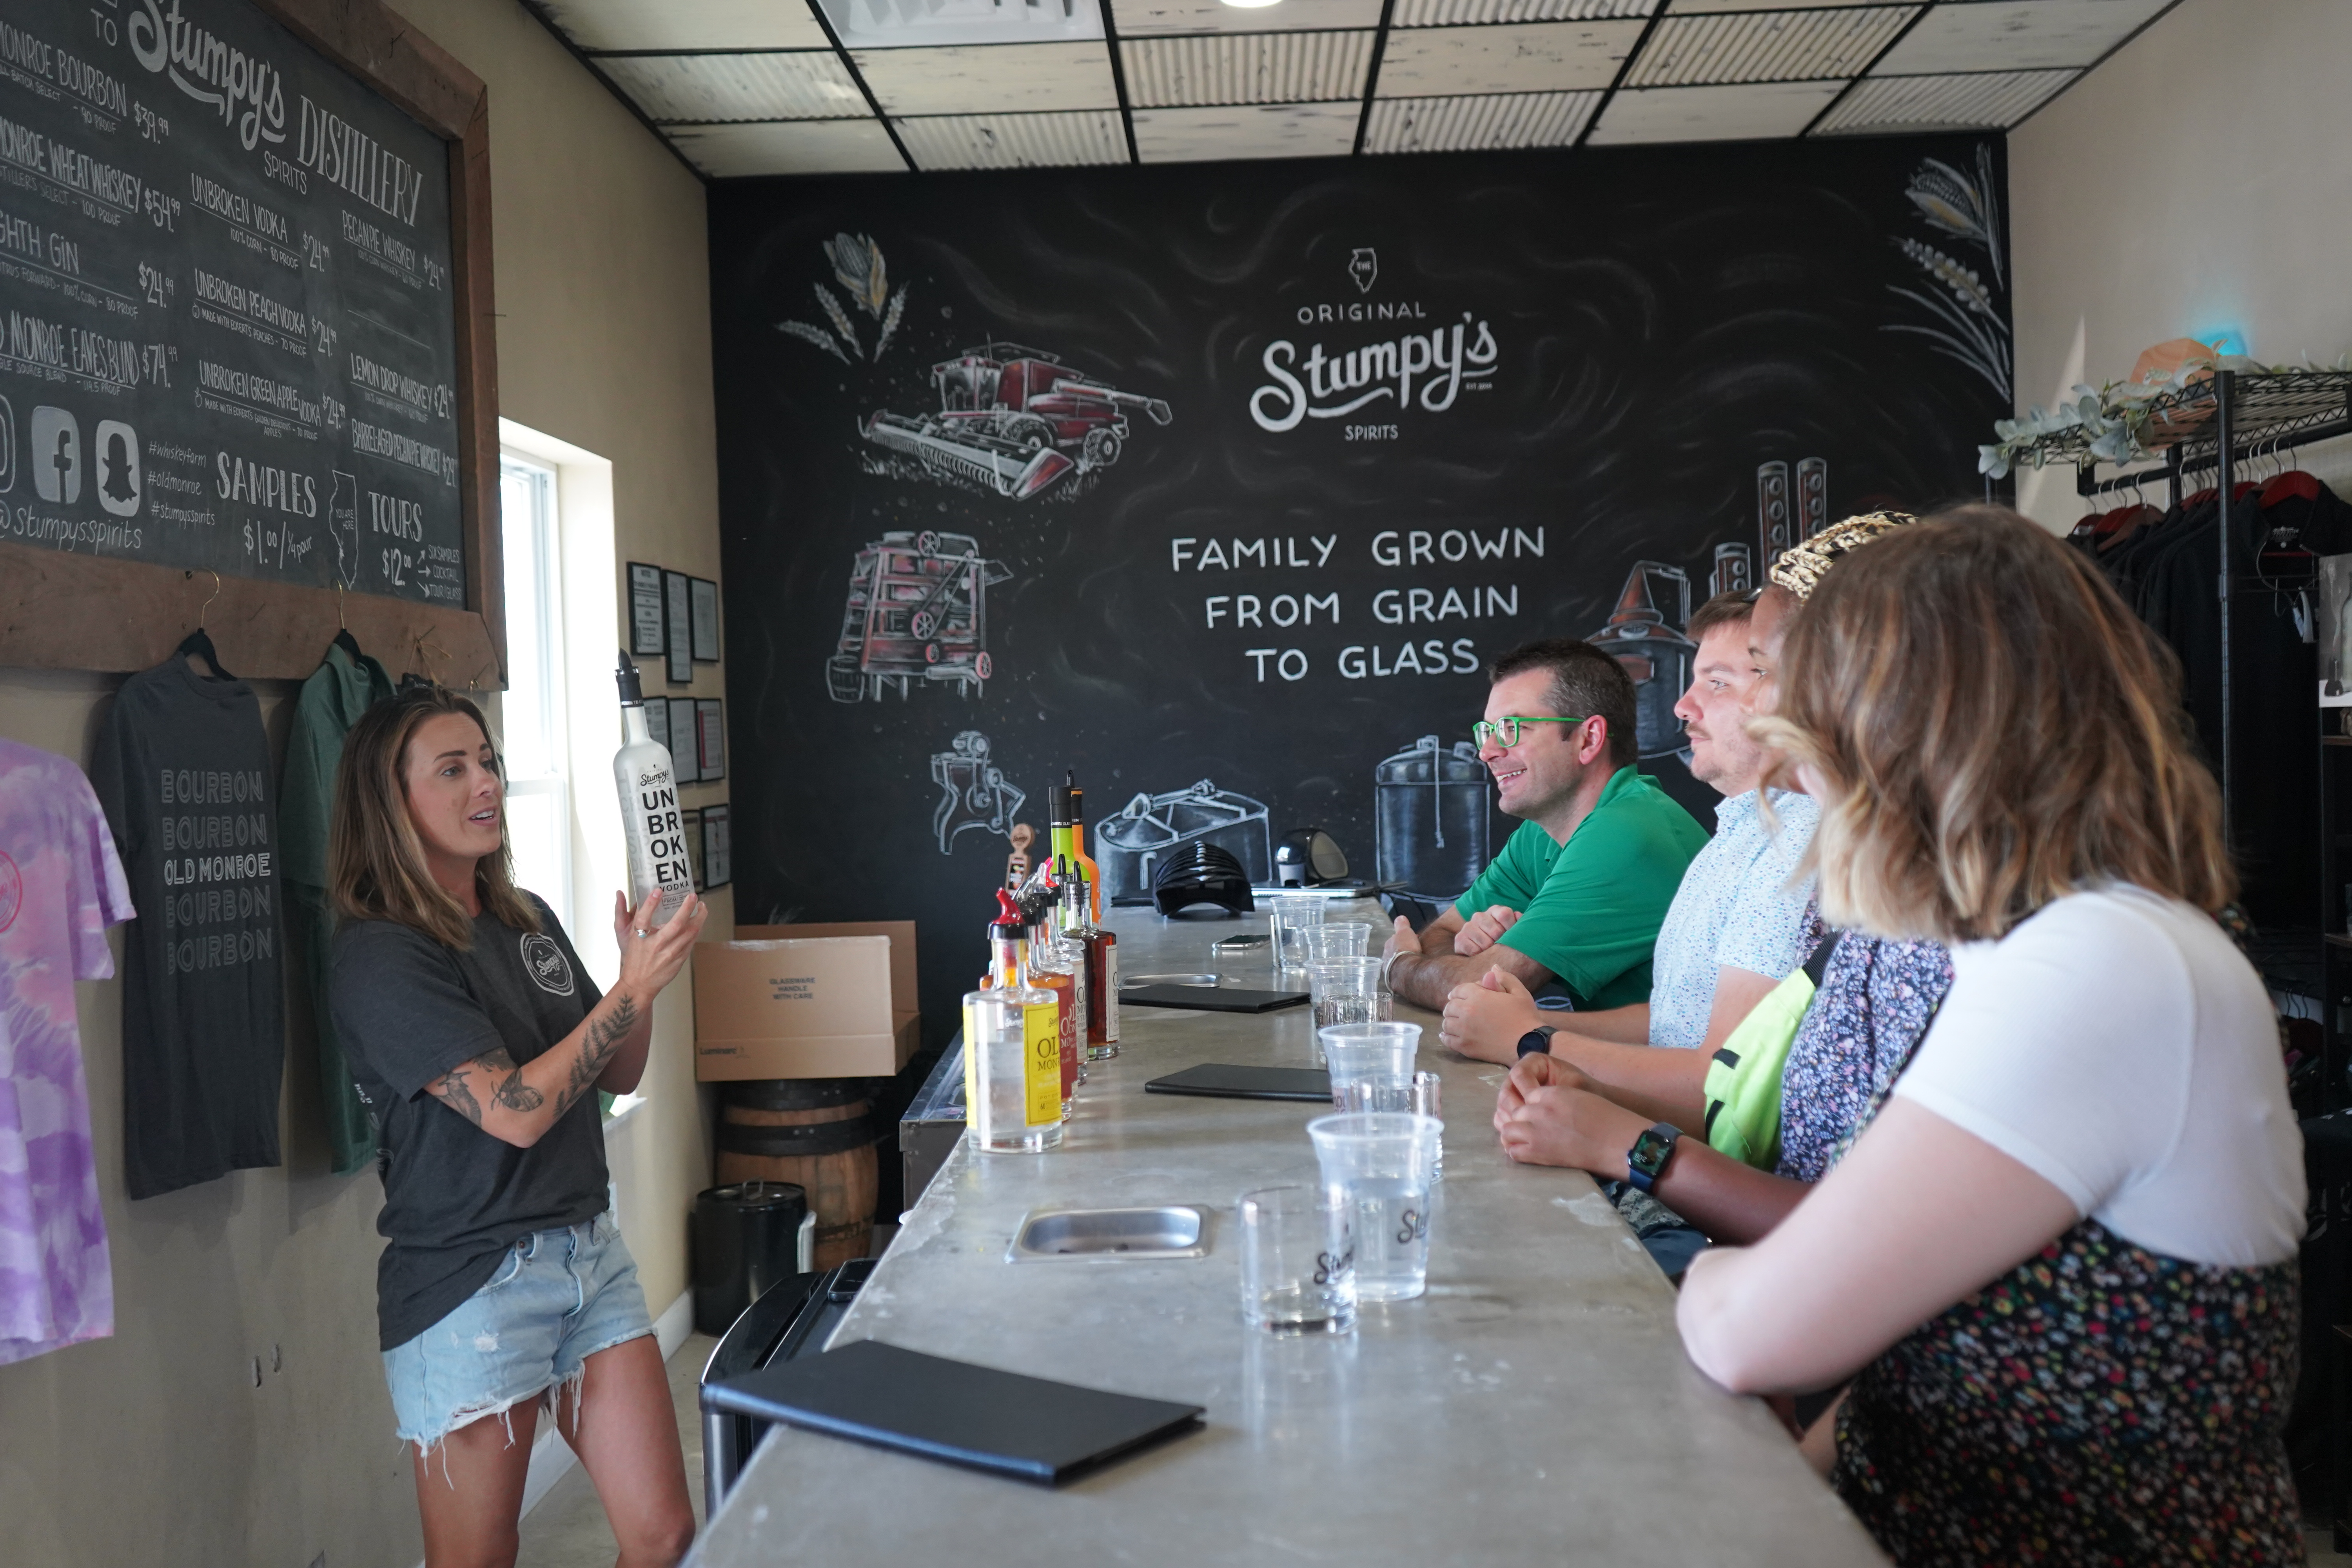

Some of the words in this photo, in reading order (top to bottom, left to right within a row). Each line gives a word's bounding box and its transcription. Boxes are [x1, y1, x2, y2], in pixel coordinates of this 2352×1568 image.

[90, 7, 118, 47] TO
[57, 49, 127, 117] BOURBON
[128, 0, 285, 151] Stumpy's
[94, 114, 116, 134] PROOF
[264, 150, 307, 195] SPIRITS
[297, 94, 423, 227] DISTILLERY
[48, 138, 89, 190] WHEAT
[145, 187, 181, 232] $54.99
[98, 206, 121, 227] PROOF
[191, 172, 250, 225] UNBROKEN
[253, 203, 289, 243] VODKA
[302, 230, 330, 272] $24.99
[230, 227, 245, 245] 100%
[246, 235, 263, 254] CORN
[270, 246, 279, 263] 80
[279, 259, 299, 270] PROOF
[381, 232, 416, 274] WHISKEY
[1357, 261, 1372, 271] THE
[138, 261, 174, 308] $24.99
[105, 296, 116, 311] 80
[117, 301, 138, 320] PROOF
[195, 268, 247, 312] UNBROKEN
[249, 290, 278, 326] PEACH
[278, 303, 307, 338] VODKA
[311, 314, 338, 358] $24.99
[1297, 301, 1427, 325] ORIGINAL
[11, 310, 68, 368] MONROE
[142, 343, 178, 388] $74.99
[201, 307, 217, 323] MADE
[252, 328, 275, 346] PEACHES
[280, 338, 289, 351] 70
[289, 340, 307, 358] PROOF
[101, 380, 120, 396] PROOF
[350, 352, 380, 388] LEMON
[380, 365, 399, 394] DROP
[399, 374, 432, 412] WHISKEY
[1250, 311, 1498, 432] Stumpy's
[199, 359, 249, 399] UNBROKEN
[250, 375, 277, 406] GREEN
[276, 383, 299, 412] APPLE
[298, 399, 322, 428] VODKA
[322, 392, 346, 430] $24.99
[204, 397, 220, 411] MADE
[263, 425, 282, 438] APPLES
[1344, 425, 1399, 441] SPIRITS
[149, 440, 207, 468] #whiskeyfarm
[148, 470, 202, 495] #oldmonroe
[216, 451, 317, 518] SAMPLES
[367, 491, 423, 543] TOURS
[296, 536, 313, 564] pour
[1172, 534, 1337, 572] FAMILY
[1371, 526, 1544, 566] GROWN
[1206, 592, 1340, 629] FROM
[1372, 584, 1518, 624] GRAIN
[1245, 648, 1308, 682] TO
[1338, 638, 1479, 680] GLASS
[161, 769, 264, 804] BOURBON
[640, 769, 669, 786] Stumpy's
[642, 788, 675, 811] UN
[162, 813, 268, 851] BOURBON
[647, 811, 679, 835] BR
[651, 835, 684, 858] OK
[163, 858, 196, 886] OLD
[198, 852, 271, 883] MONROE
[655, 858, 688, 884] EN
[659, 880, 689, 893] VODKA
[165, 885, 271, 929] BOURBON
[167, 923, 273, 976] BOURBON
[1037, 1036, 1060, 1058] OL
[1037, 1057, 1060, 1071] MON
